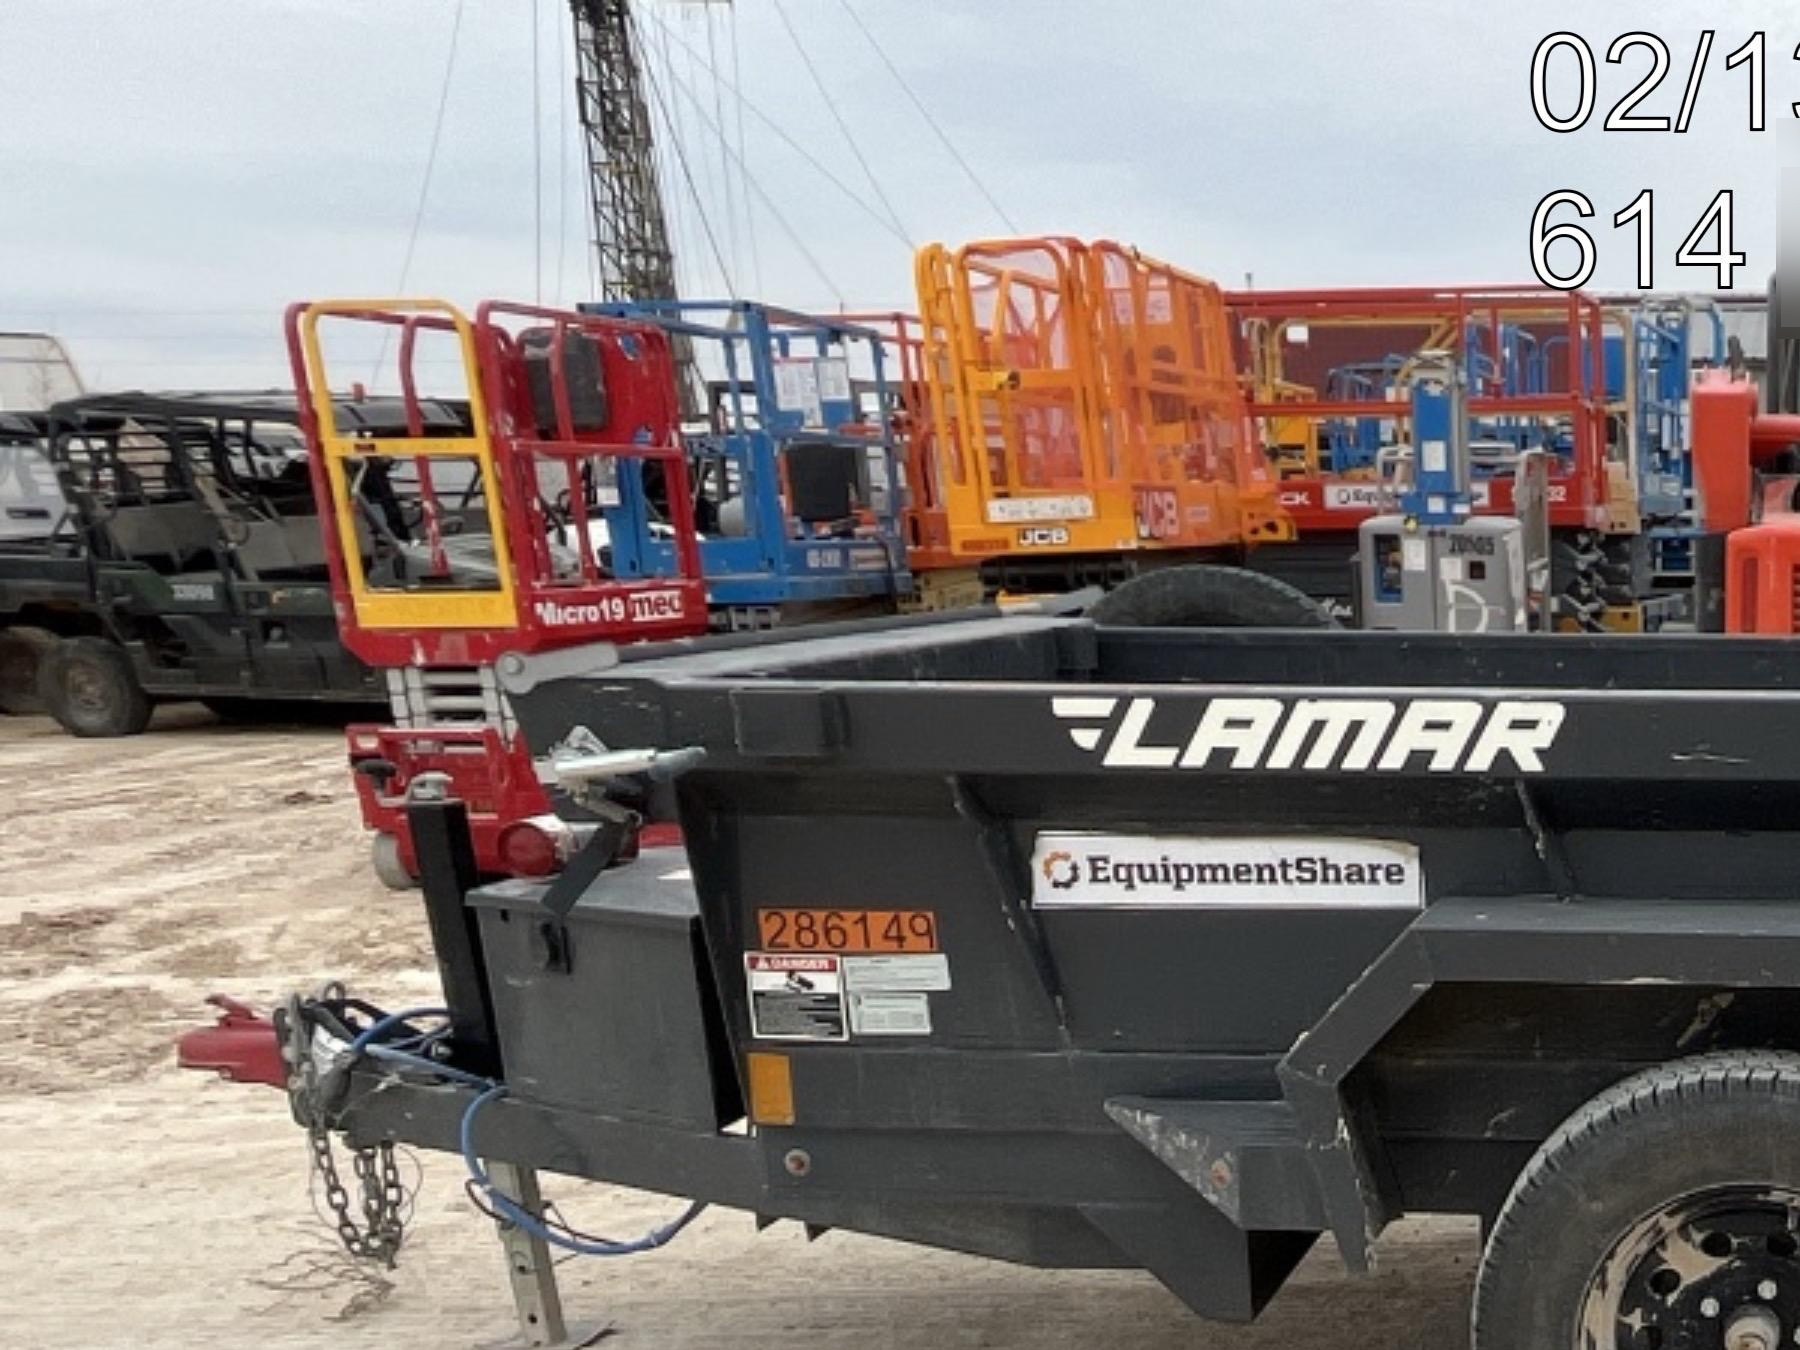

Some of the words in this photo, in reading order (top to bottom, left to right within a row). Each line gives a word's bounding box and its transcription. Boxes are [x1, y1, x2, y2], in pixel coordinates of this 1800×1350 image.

[1018, 527, 1069, 546] JCB
[1102, 697, 1566, 772] LAMAR
[1087, 855, 1407, 892] EquipmentShare
[763, 911, 935, 949] 286149
